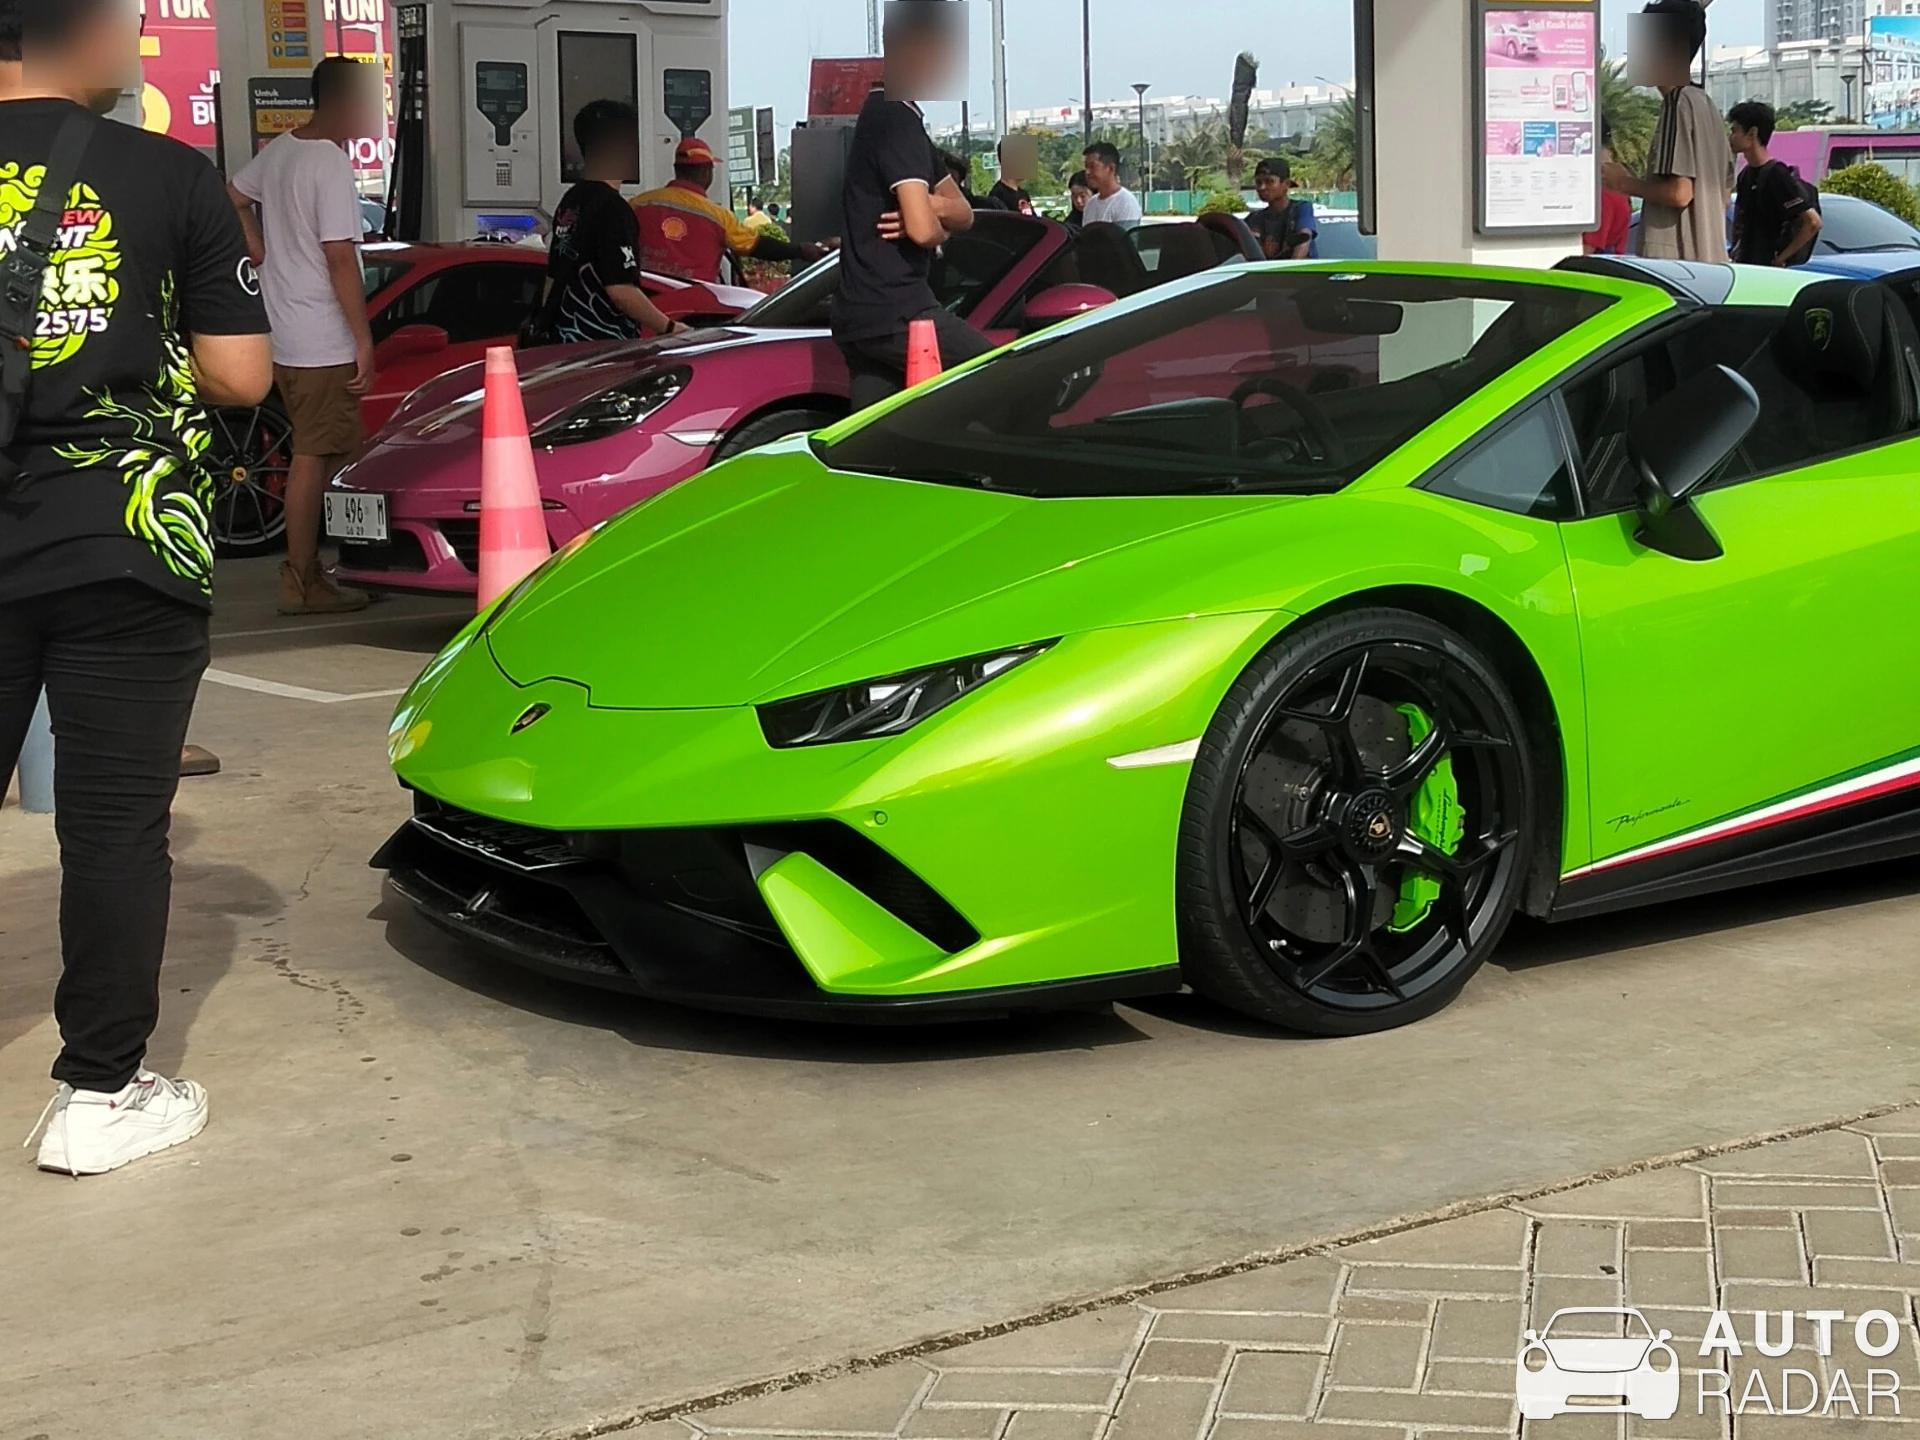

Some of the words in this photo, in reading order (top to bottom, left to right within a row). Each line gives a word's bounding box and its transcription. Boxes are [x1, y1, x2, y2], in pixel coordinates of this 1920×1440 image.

[254, 88, 279, 97] Untuk
[255, 98, 308, 106] Keselamatan
[34, 307, 108, 336] 2575
[326, 496, 333, 522] B
